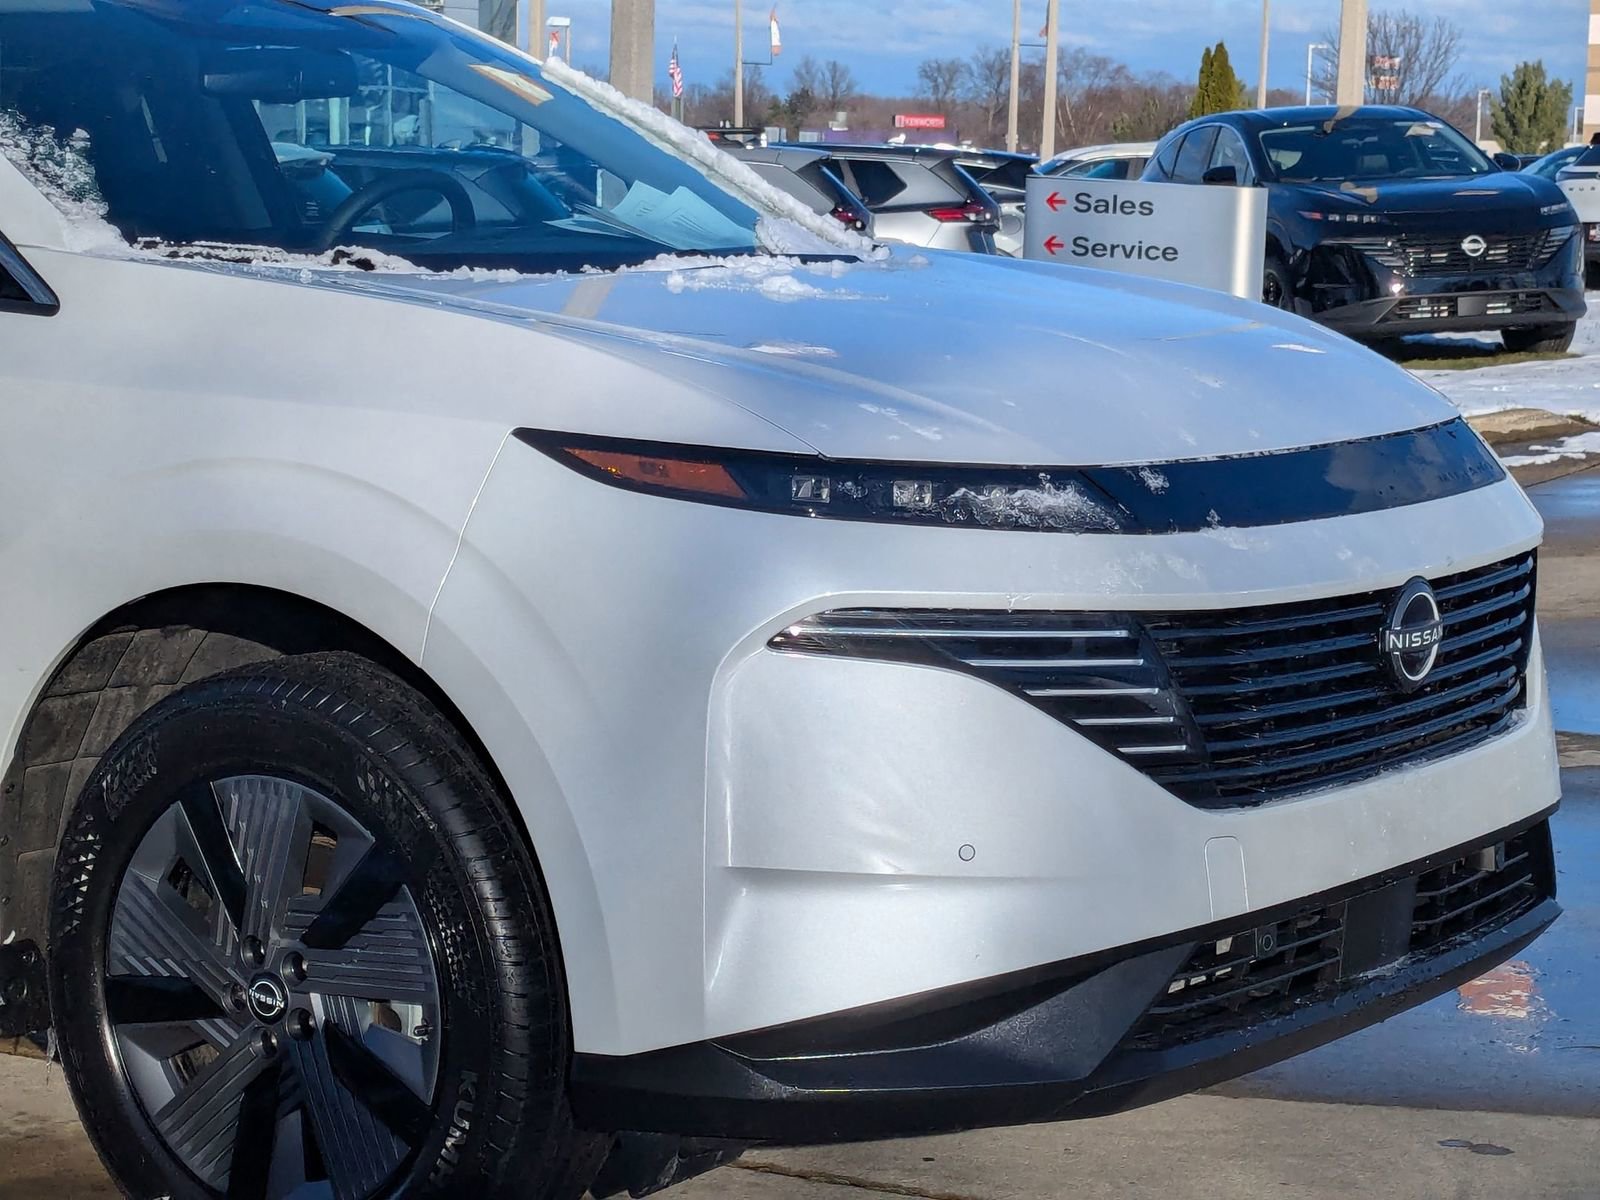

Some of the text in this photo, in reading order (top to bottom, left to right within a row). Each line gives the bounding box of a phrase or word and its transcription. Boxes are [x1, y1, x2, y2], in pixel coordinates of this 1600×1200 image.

[1073, 192, 1154, 217] Sales
[1071, 236, 1179, 262] Service
[1389, 624, 1443, 649] NISSAN
